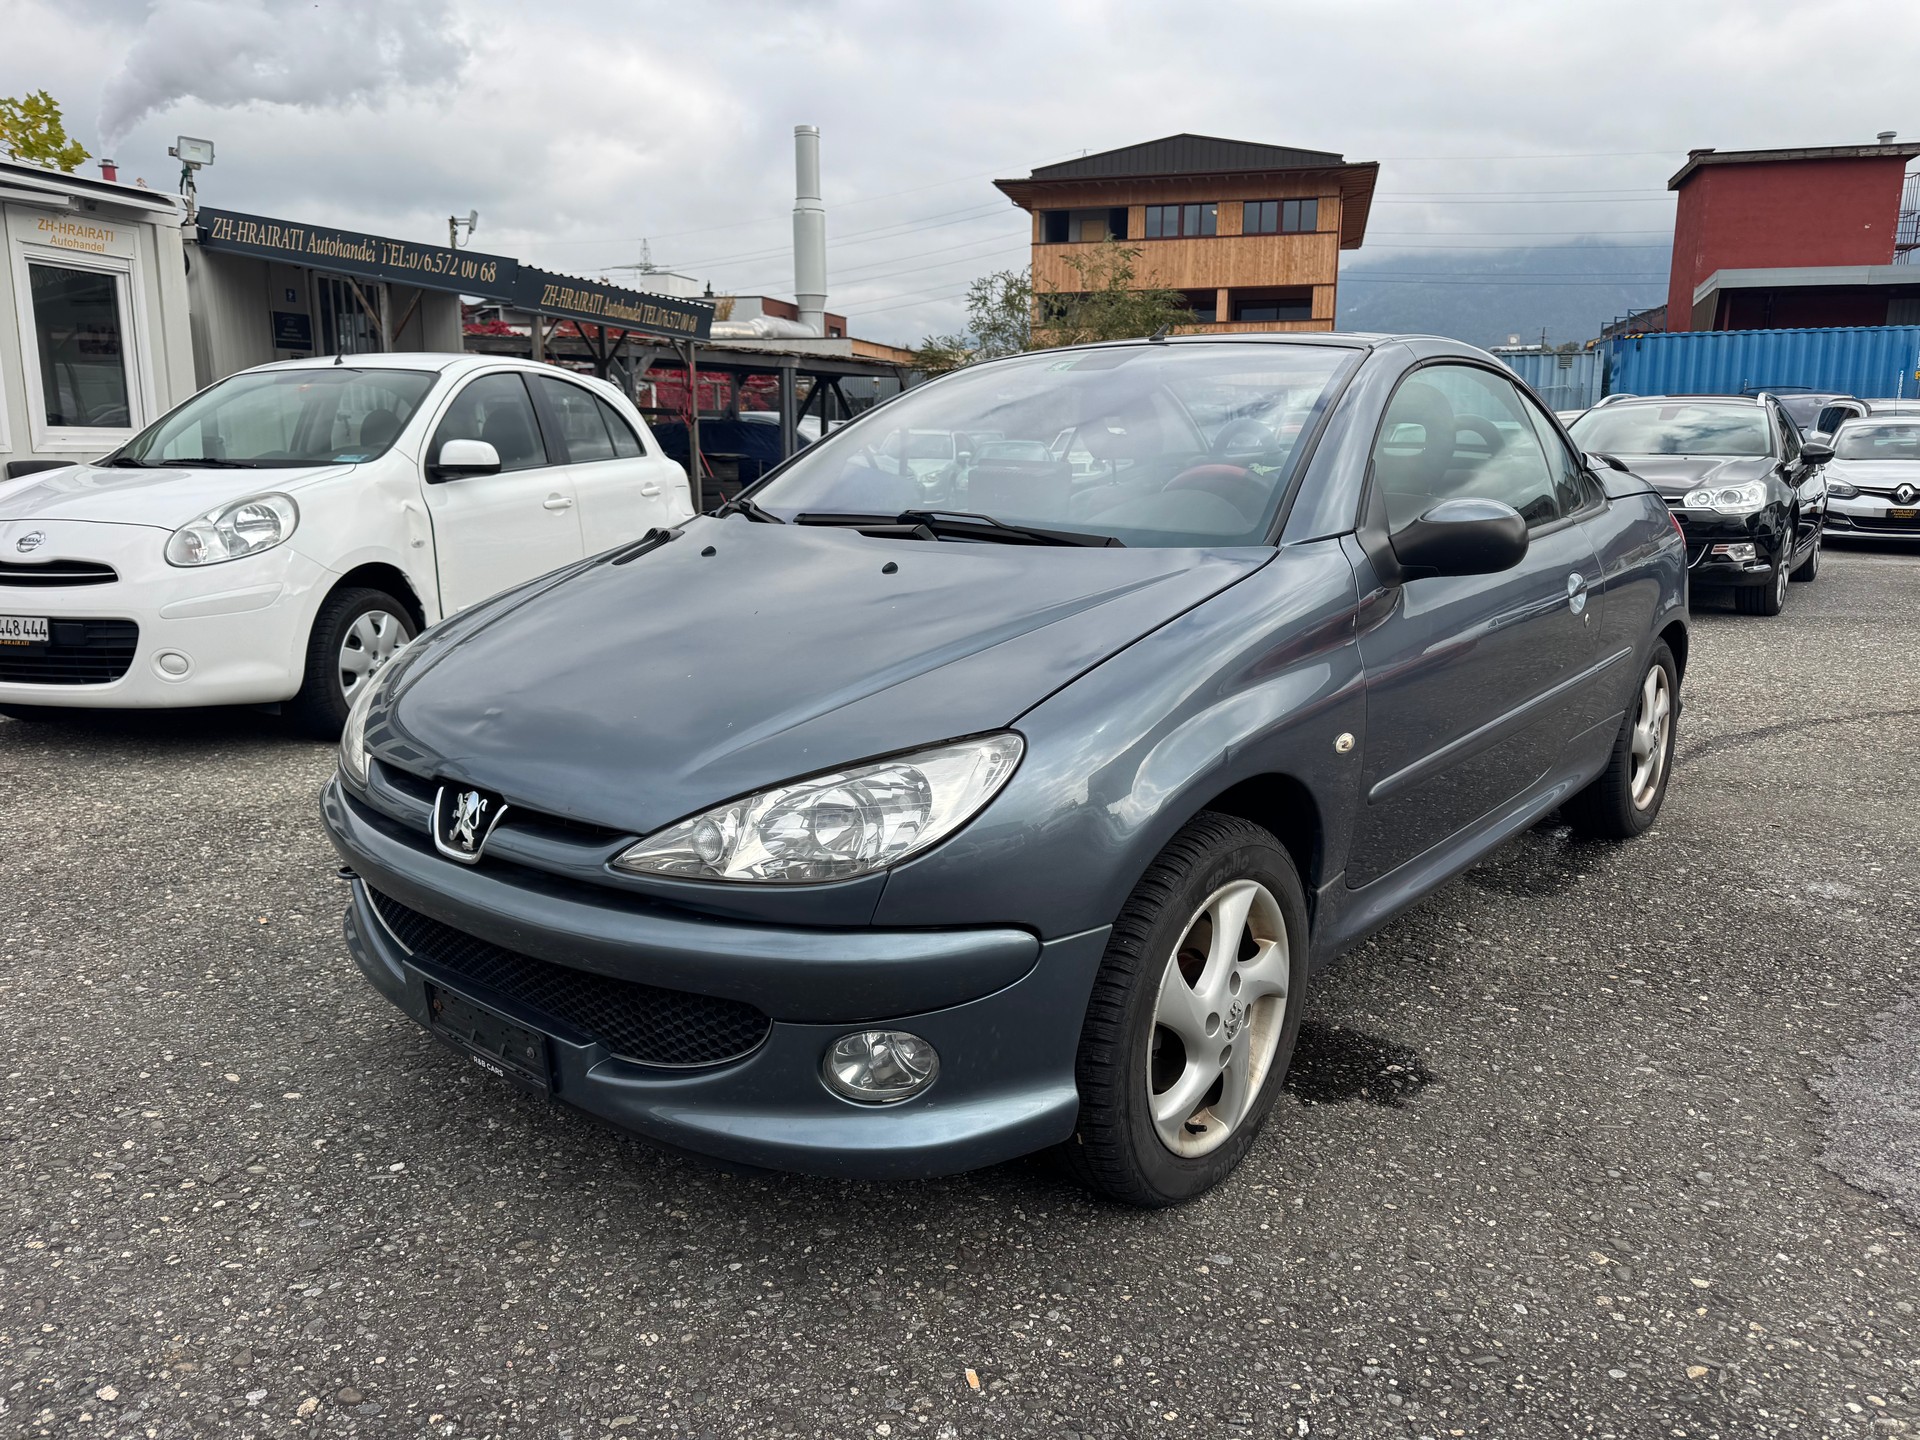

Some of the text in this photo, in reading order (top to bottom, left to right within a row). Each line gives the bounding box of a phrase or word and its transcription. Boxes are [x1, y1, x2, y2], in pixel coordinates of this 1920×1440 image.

[38, 218, 114, 242] ZH-HRAIRATI
[50, 234, 105, 252] Autohandel
[211, 217, 304, 252] ZH-HRAIRATI
[480, 261, 497, 283] 68
[540, 284, 604, 314] ZH-HRAIRATI
[473, 1055, 504, 1077] R&B CARS
